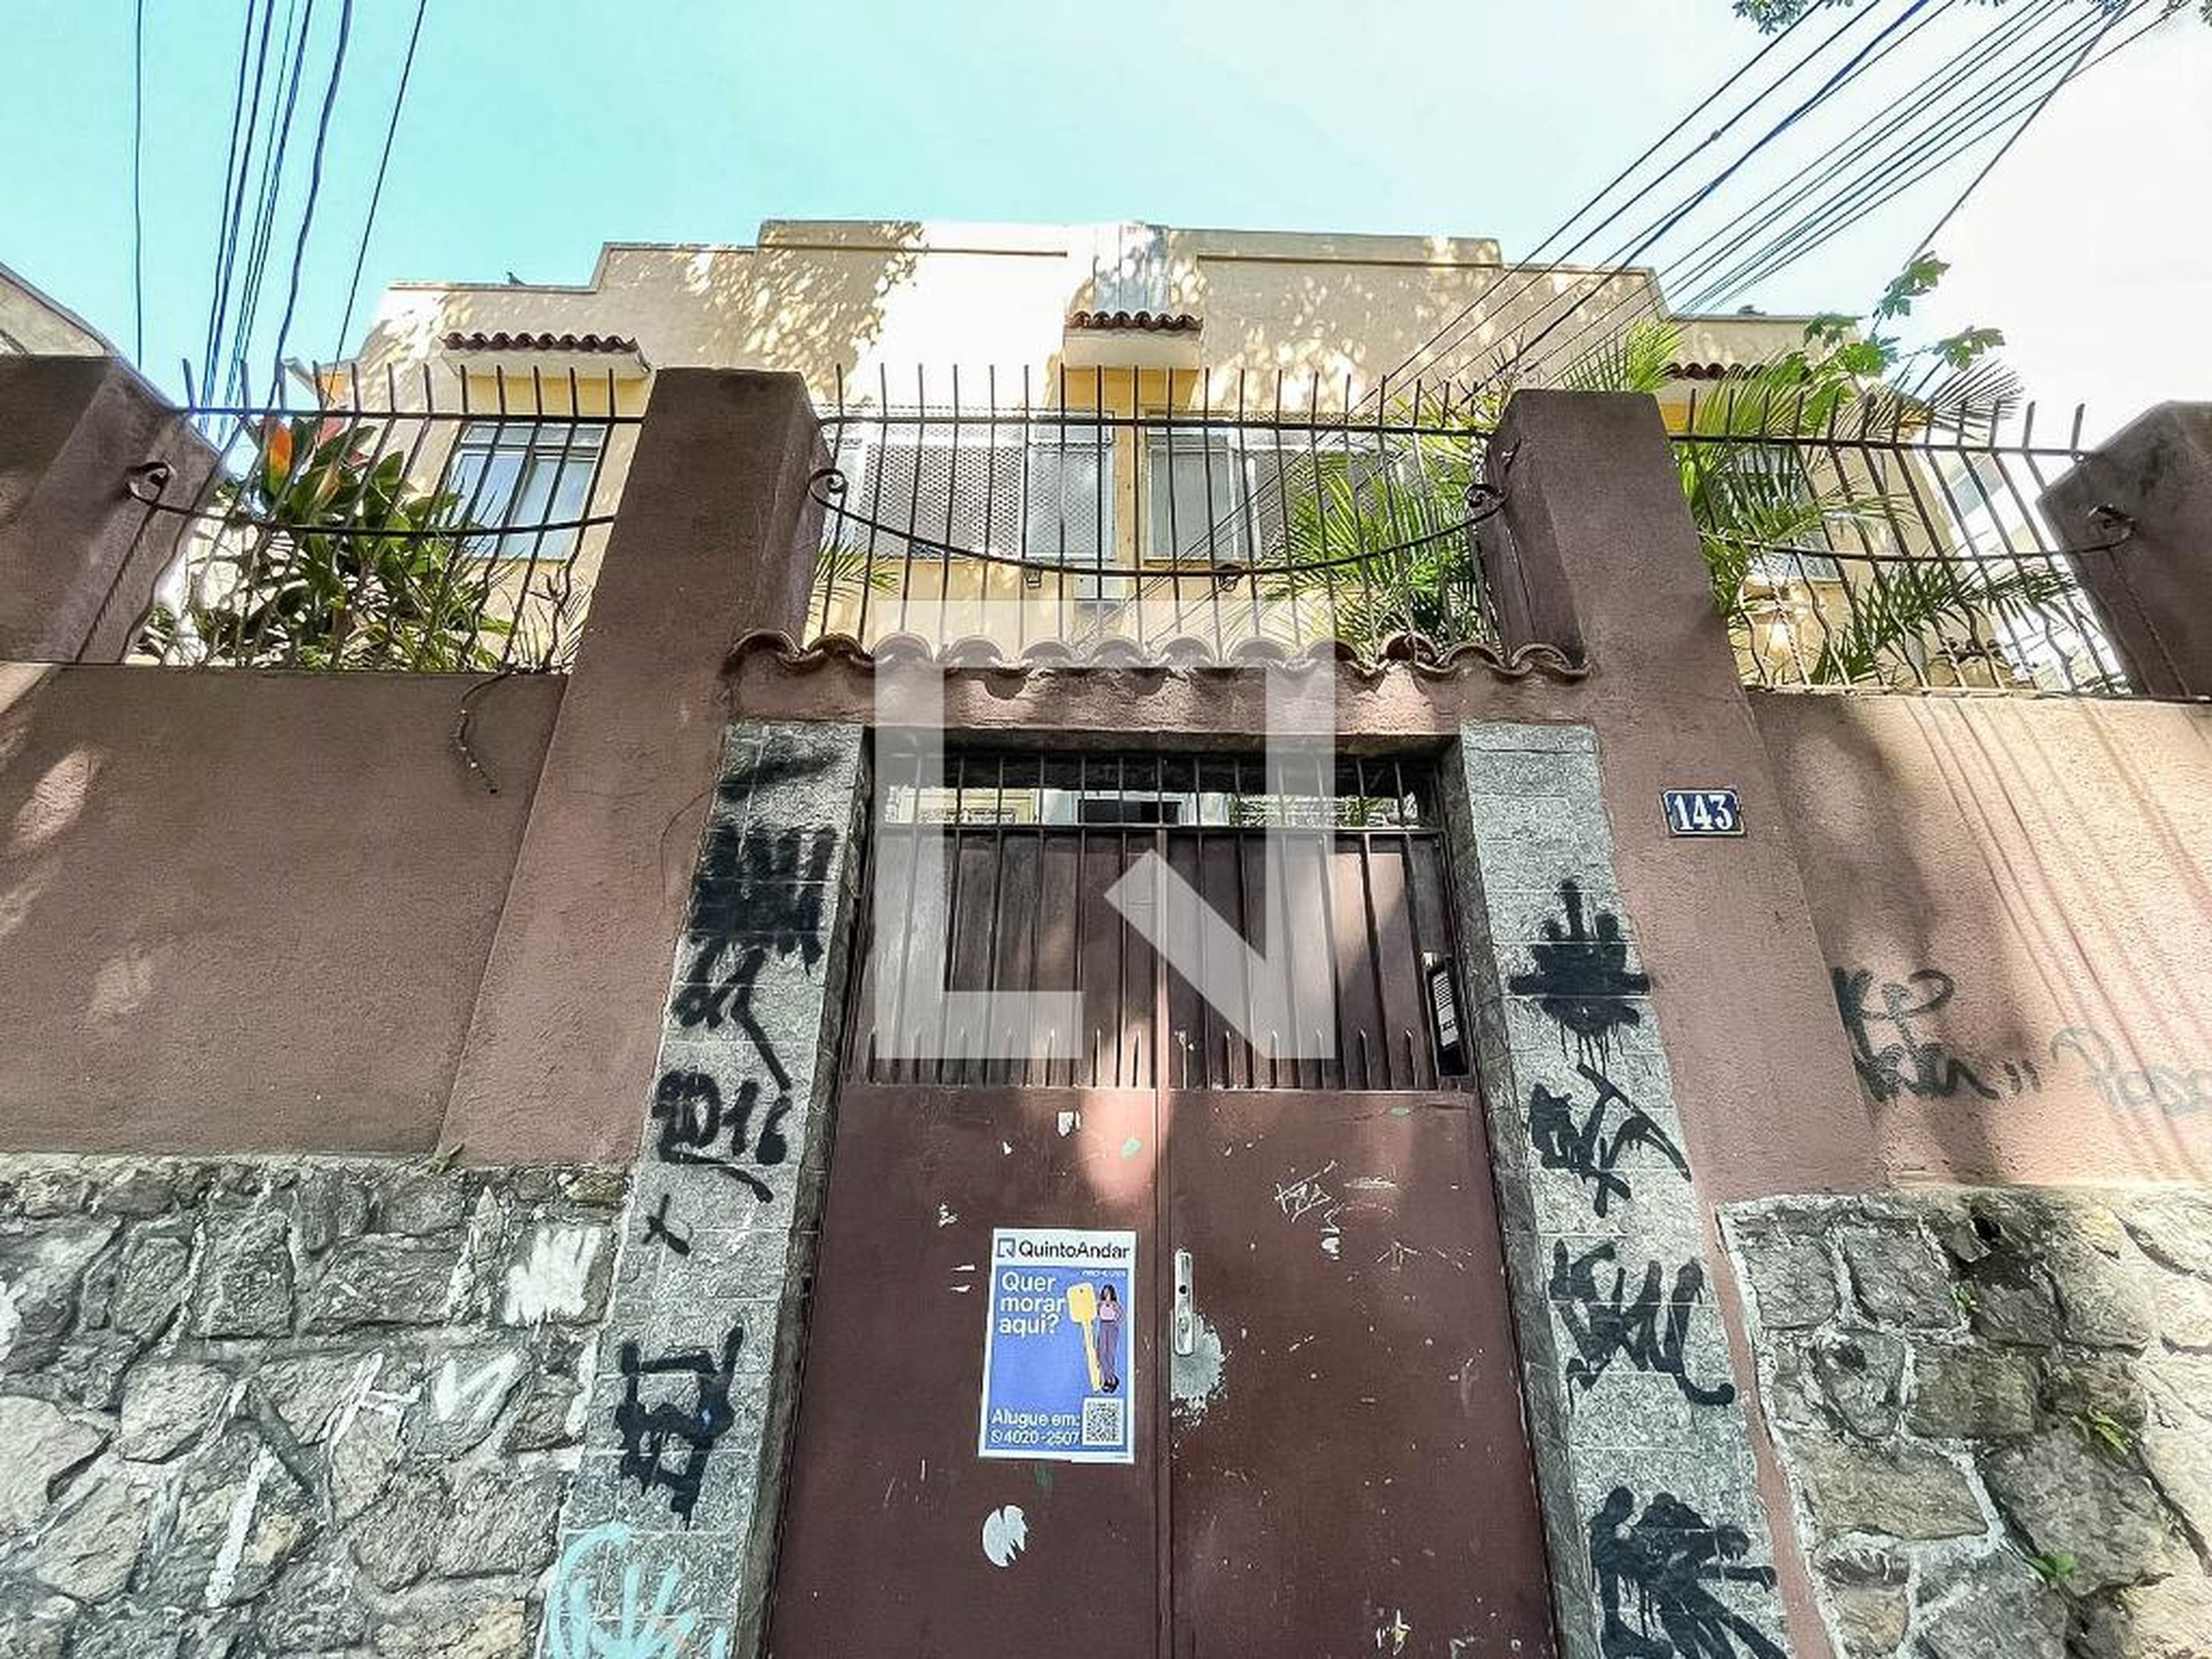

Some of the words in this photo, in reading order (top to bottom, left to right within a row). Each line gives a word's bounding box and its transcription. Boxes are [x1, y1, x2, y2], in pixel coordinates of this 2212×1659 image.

[1674, 794, 1733, 830] 143
[1018, 1239, 1130, 1257] QuintoAndar
[1002, 1271, 1056, 1291] Quer
[1001, 1297, 1065, 1312] morar
[999, 1314, 1059, 1338] aqui?
[991, 1409, 1049, 1429] Alugue
